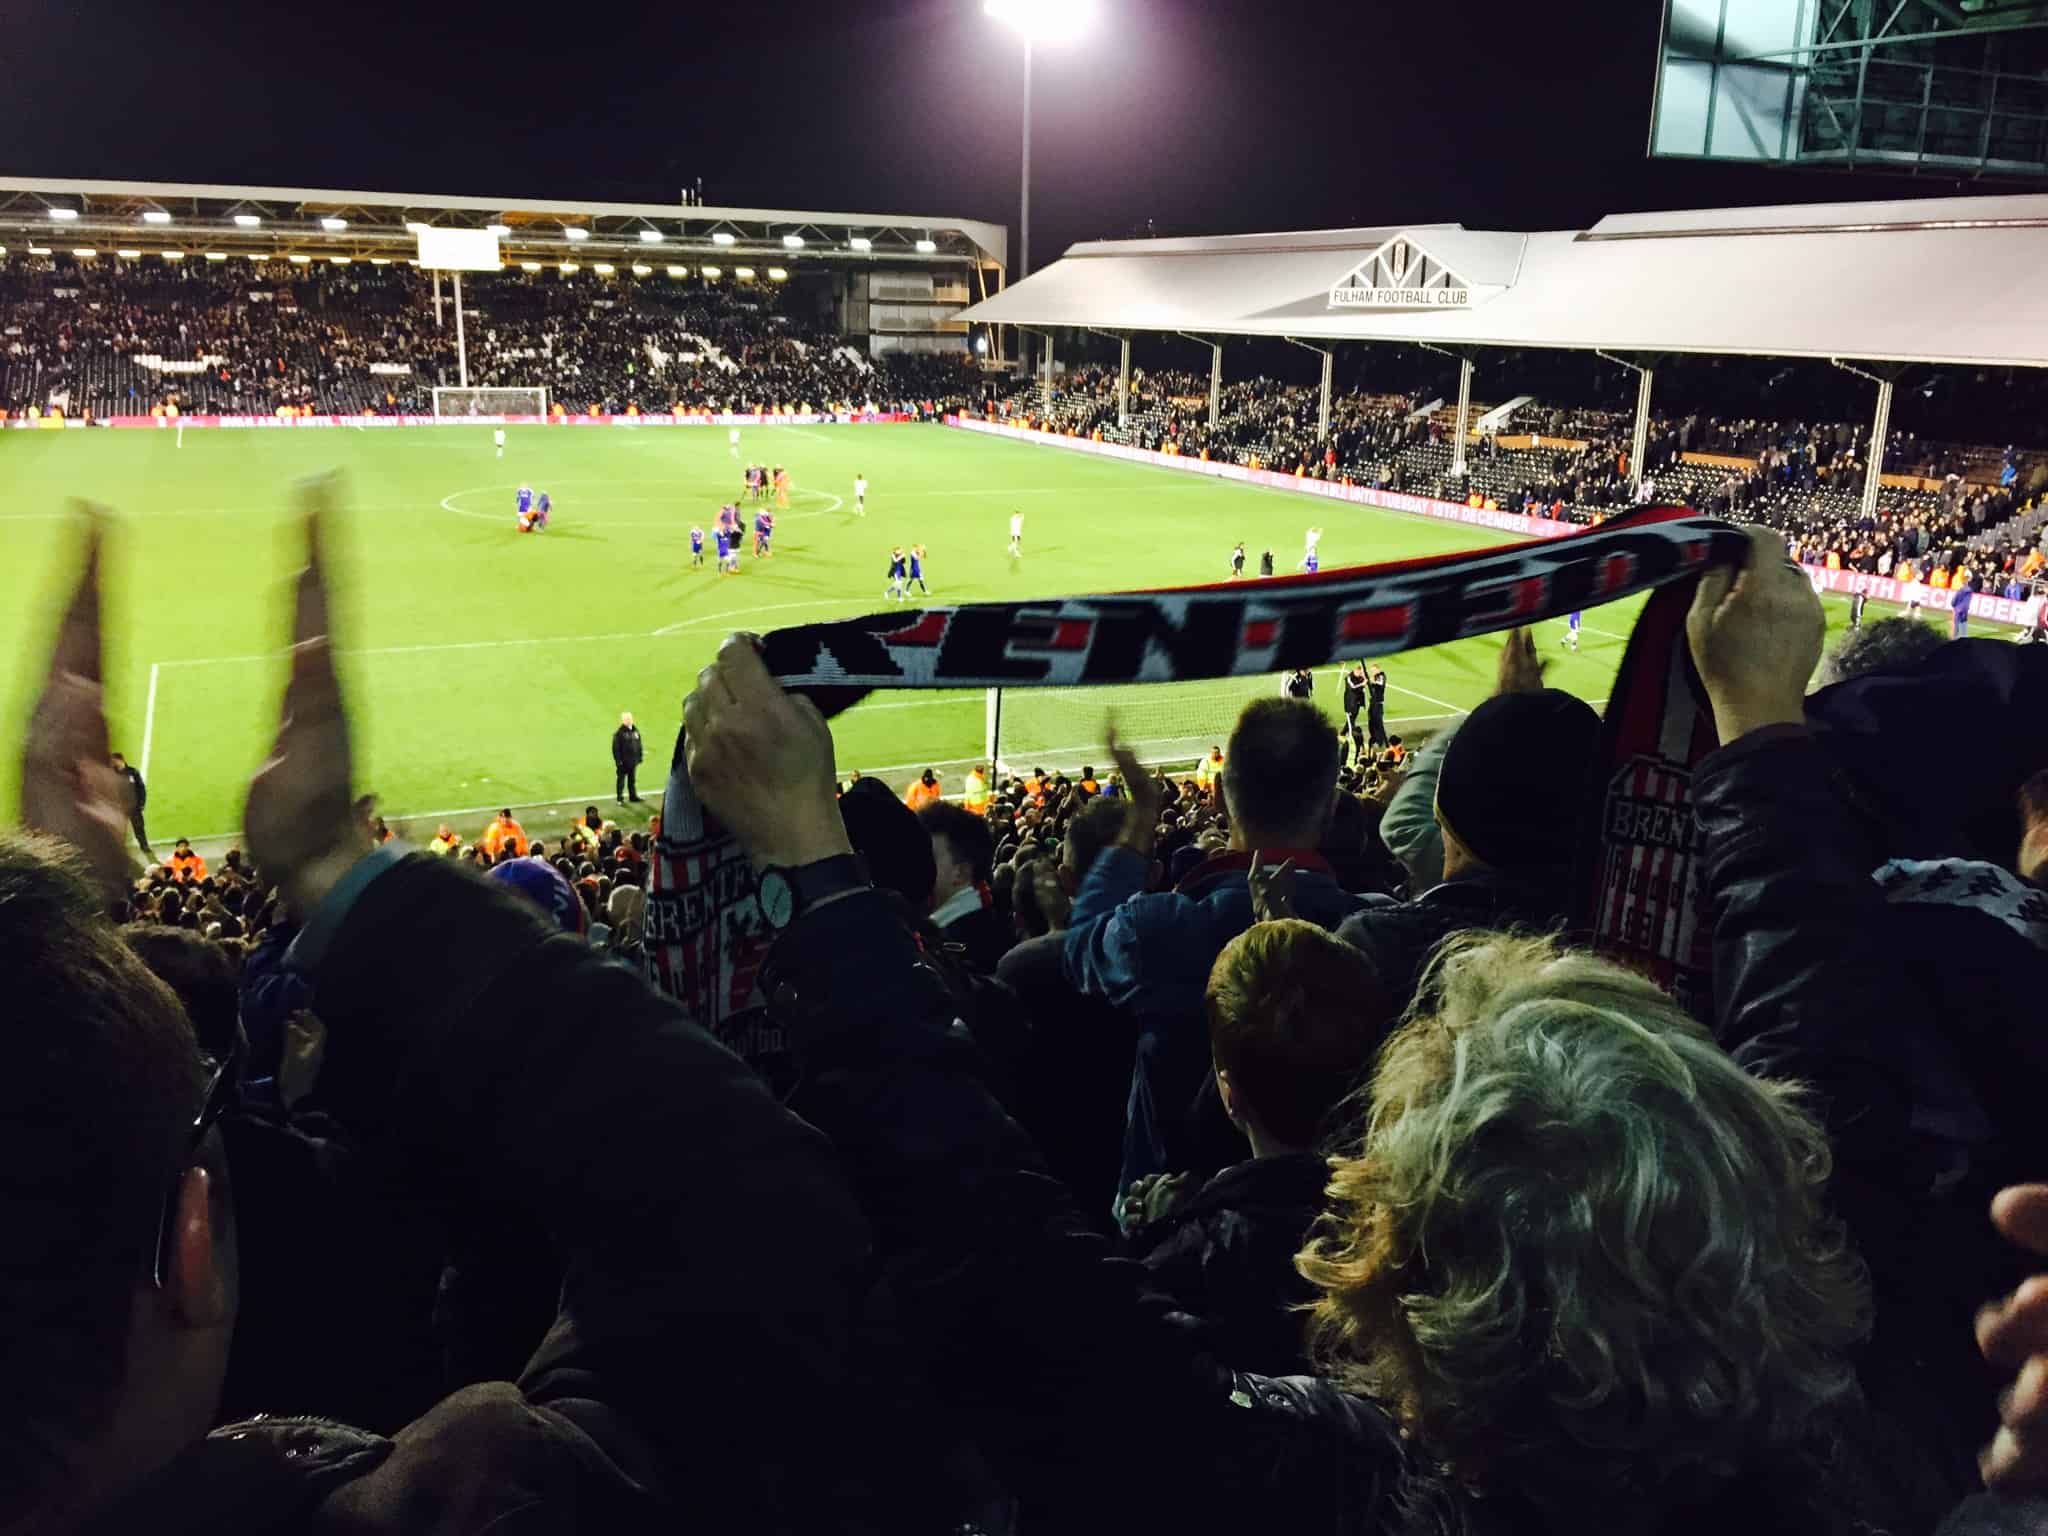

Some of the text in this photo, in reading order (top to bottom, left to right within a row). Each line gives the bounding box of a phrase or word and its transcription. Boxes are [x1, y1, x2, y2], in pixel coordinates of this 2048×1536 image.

[1333, 290, 1468, 304] FULHAM FOOTBALL CLUB
[1462, 506, 1528, 532] DECEMBER
